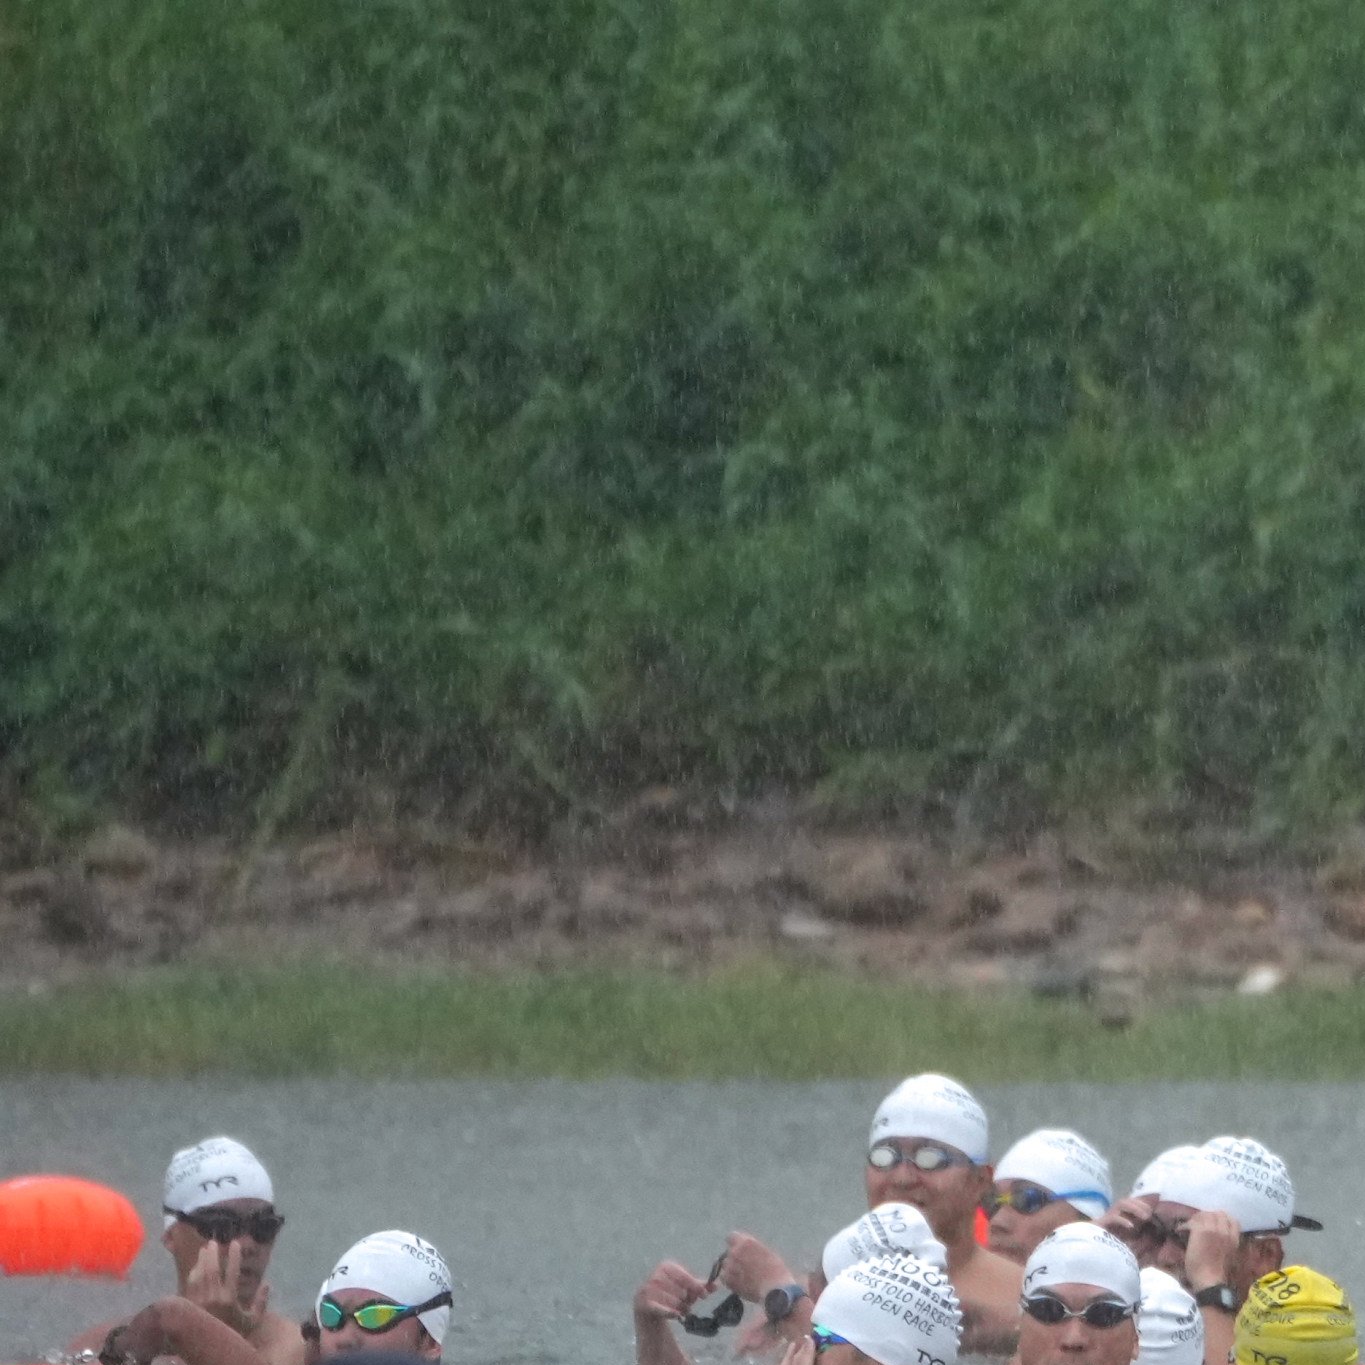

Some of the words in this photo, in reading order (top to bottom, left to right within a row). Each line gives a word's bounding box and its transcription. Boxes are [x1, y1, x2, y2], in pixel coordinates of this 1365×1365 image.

[200, 1176, 239, 1192] TYR
[1226, 1172, 1263, 1193] OPEN
[862, 1291, 901, 1316] OPEN
[903, 1309, 936, 1337] RACE
